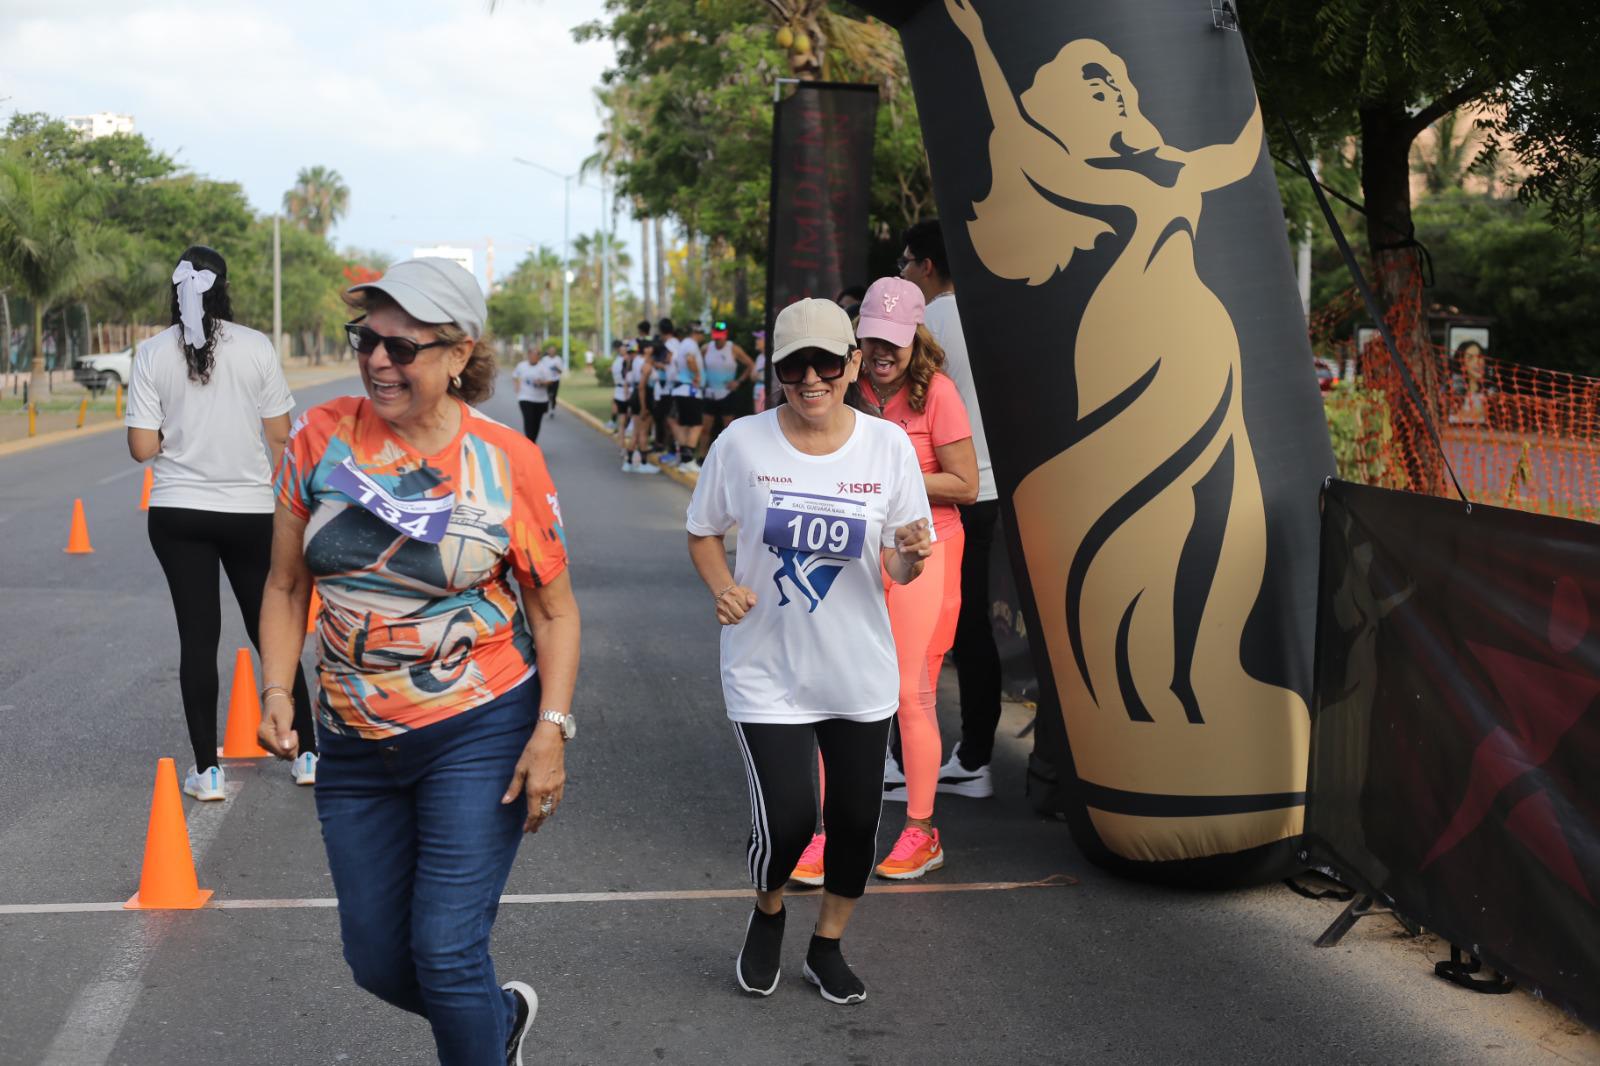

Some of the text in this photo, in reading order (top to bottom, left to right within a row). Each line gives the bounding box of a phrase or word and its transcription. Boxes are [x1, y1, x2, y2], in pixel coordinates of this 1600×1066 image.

[757, 475, 792, 484] SINALOA
[849, 482, 882, 494] ISDE
[358, 484, 431, 538] 134
[787, 514, 850, 553] 109
